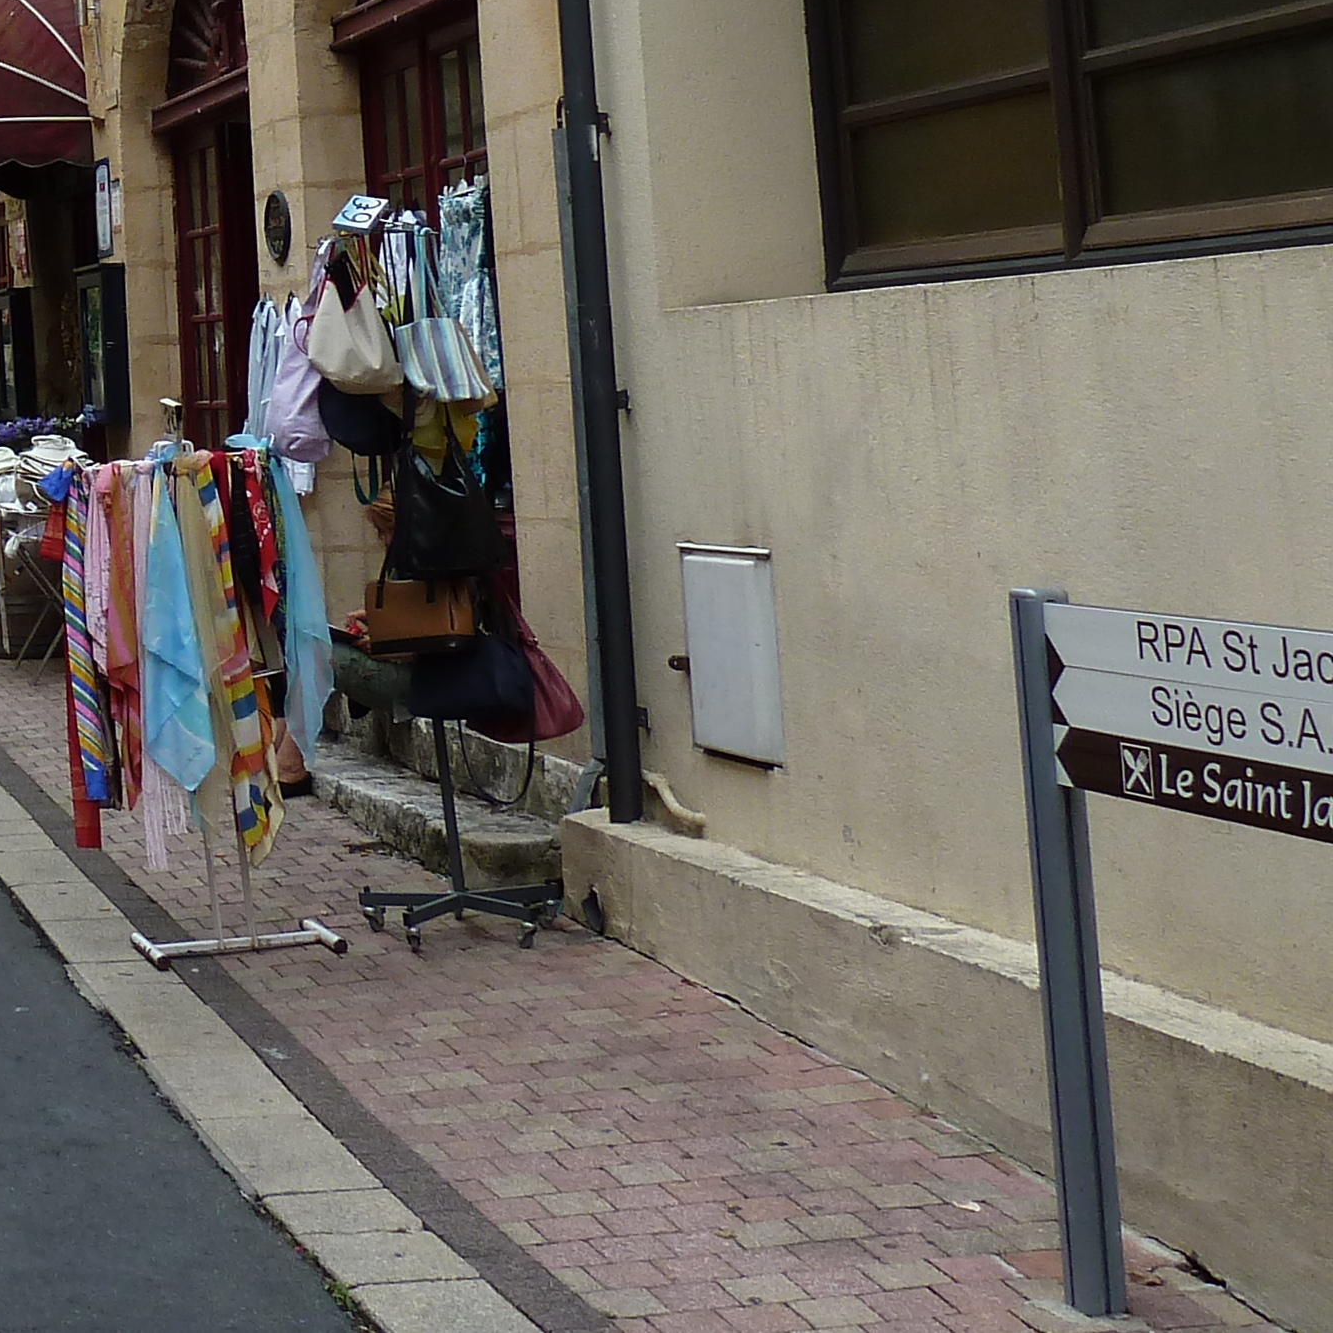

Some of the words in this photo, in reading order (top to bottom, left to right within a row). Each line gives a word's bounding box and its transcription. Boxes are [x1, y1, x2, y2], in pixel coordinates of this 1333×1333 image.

[1136, 620, 1212, 669] RPA
[1222, 630, 1261, 675] St
[1151, 686, 1247, 746] Siège
[1159, 753, 1195, 799] Le
[1202, 762, 1293, 819] Saint
